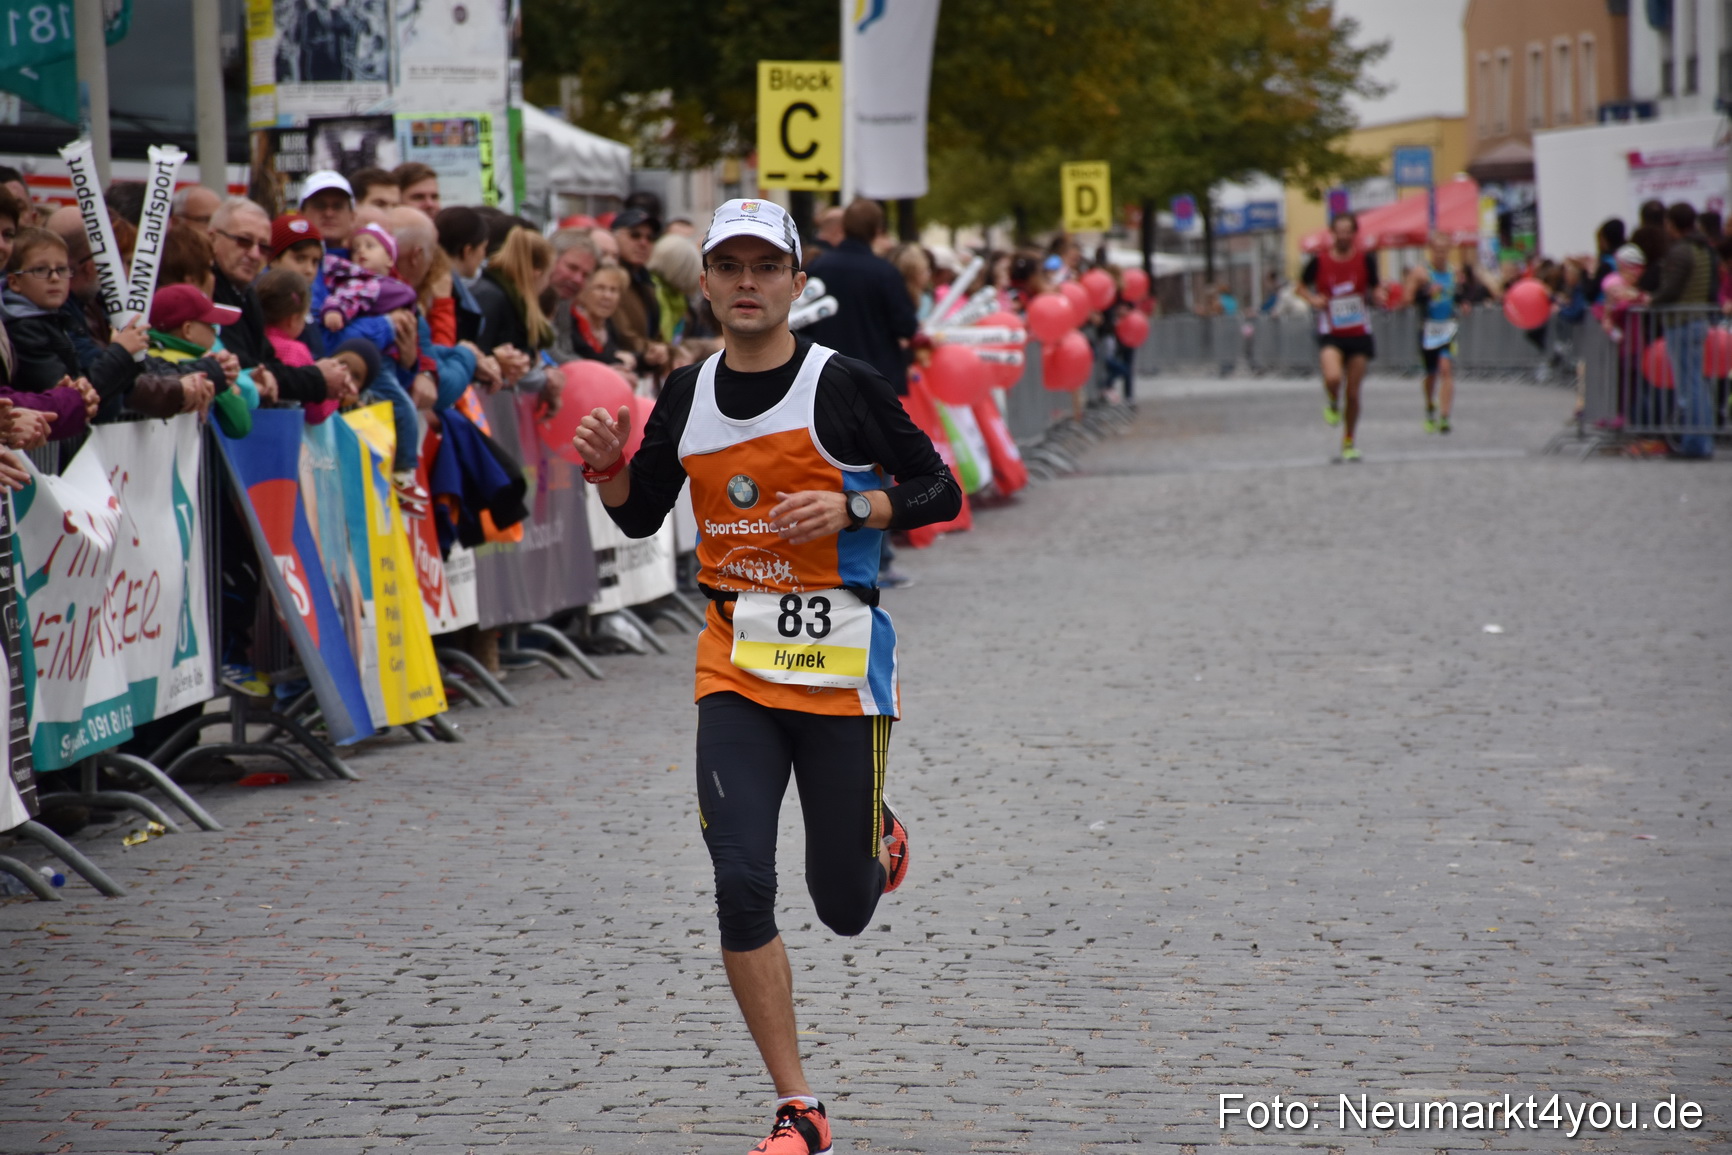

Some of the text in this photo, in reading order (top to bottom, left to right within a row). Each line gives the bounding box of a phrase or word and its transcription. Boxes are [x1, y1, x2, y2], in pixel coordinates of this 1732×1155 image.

[769, 67, 833, 91] Block
[780, 101, 819, 161] C
[1075, 184, 1099, 217] D
[66, 156, 124, 316] BMW Laufsport
[127, 160, 174, 313] BMW Laufsport
[729, 476, 754, 488] BMW
[704, 518, 799, 537] SportSch
[777, 593, 832, 639] 83
[739, 631, 746, 640] A
[773, 649, 826, 670] Hynek
